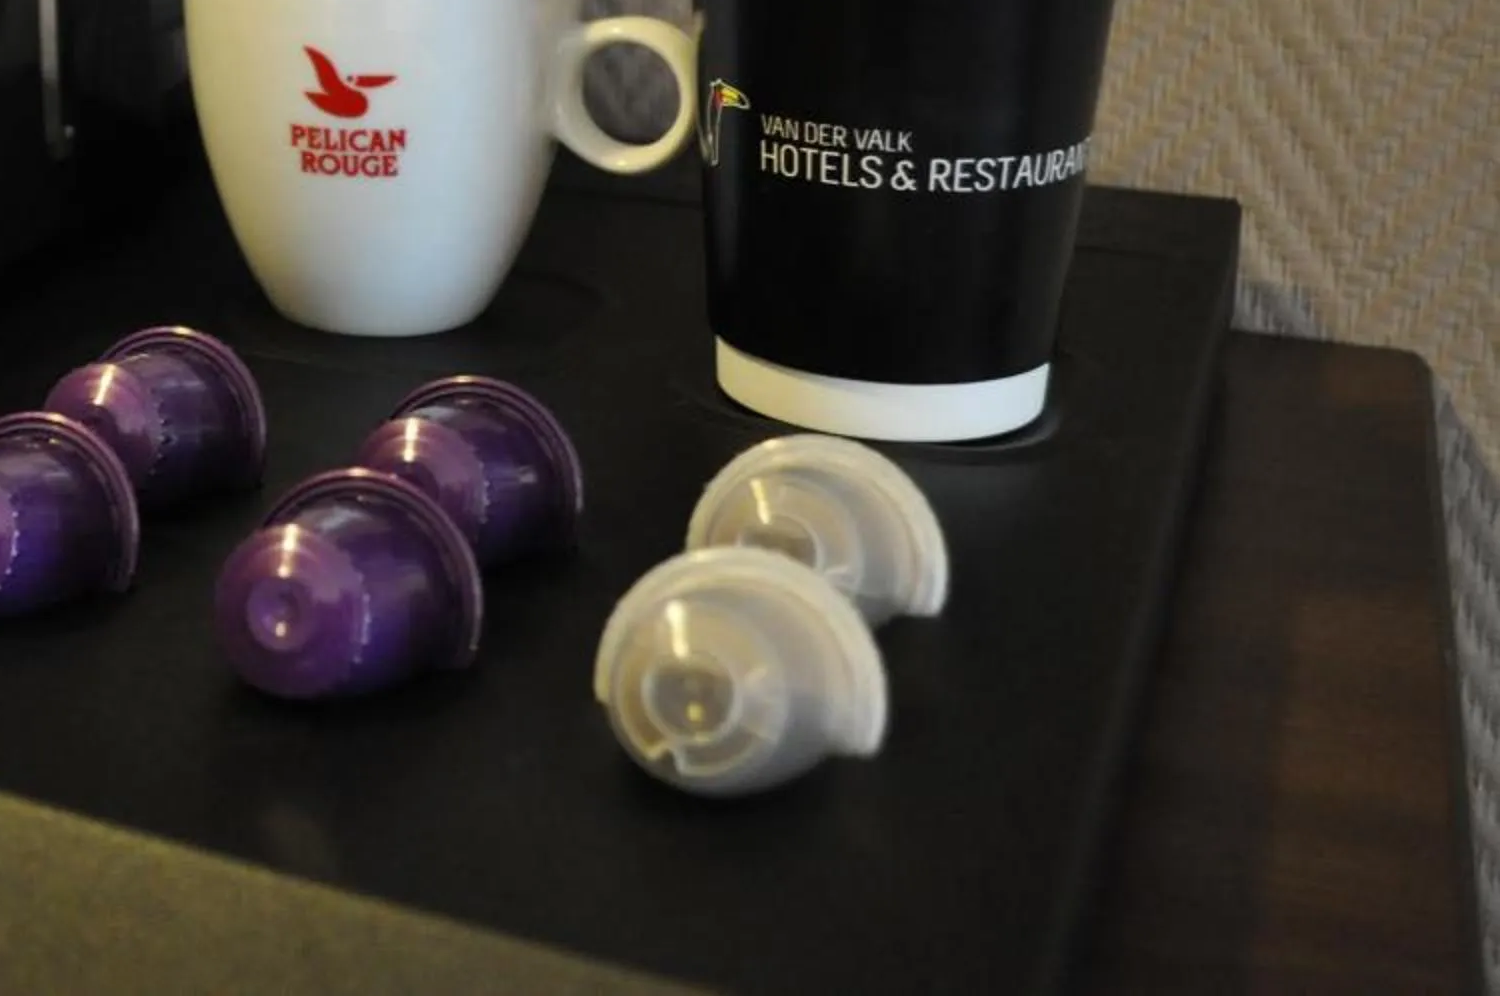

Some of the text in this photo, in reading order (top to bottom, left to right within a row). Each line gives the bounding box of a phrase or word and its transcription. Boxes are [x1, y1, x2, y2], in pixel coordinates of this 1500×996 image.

[291, 124, 406, 152] PELICAN
[761, 113, 913, 152] VAN DER VALK
[301, 151, 398, 177] ROUGE
[760, 139, 883, 189] HOTELS
[890, 159, 917, 191] &
